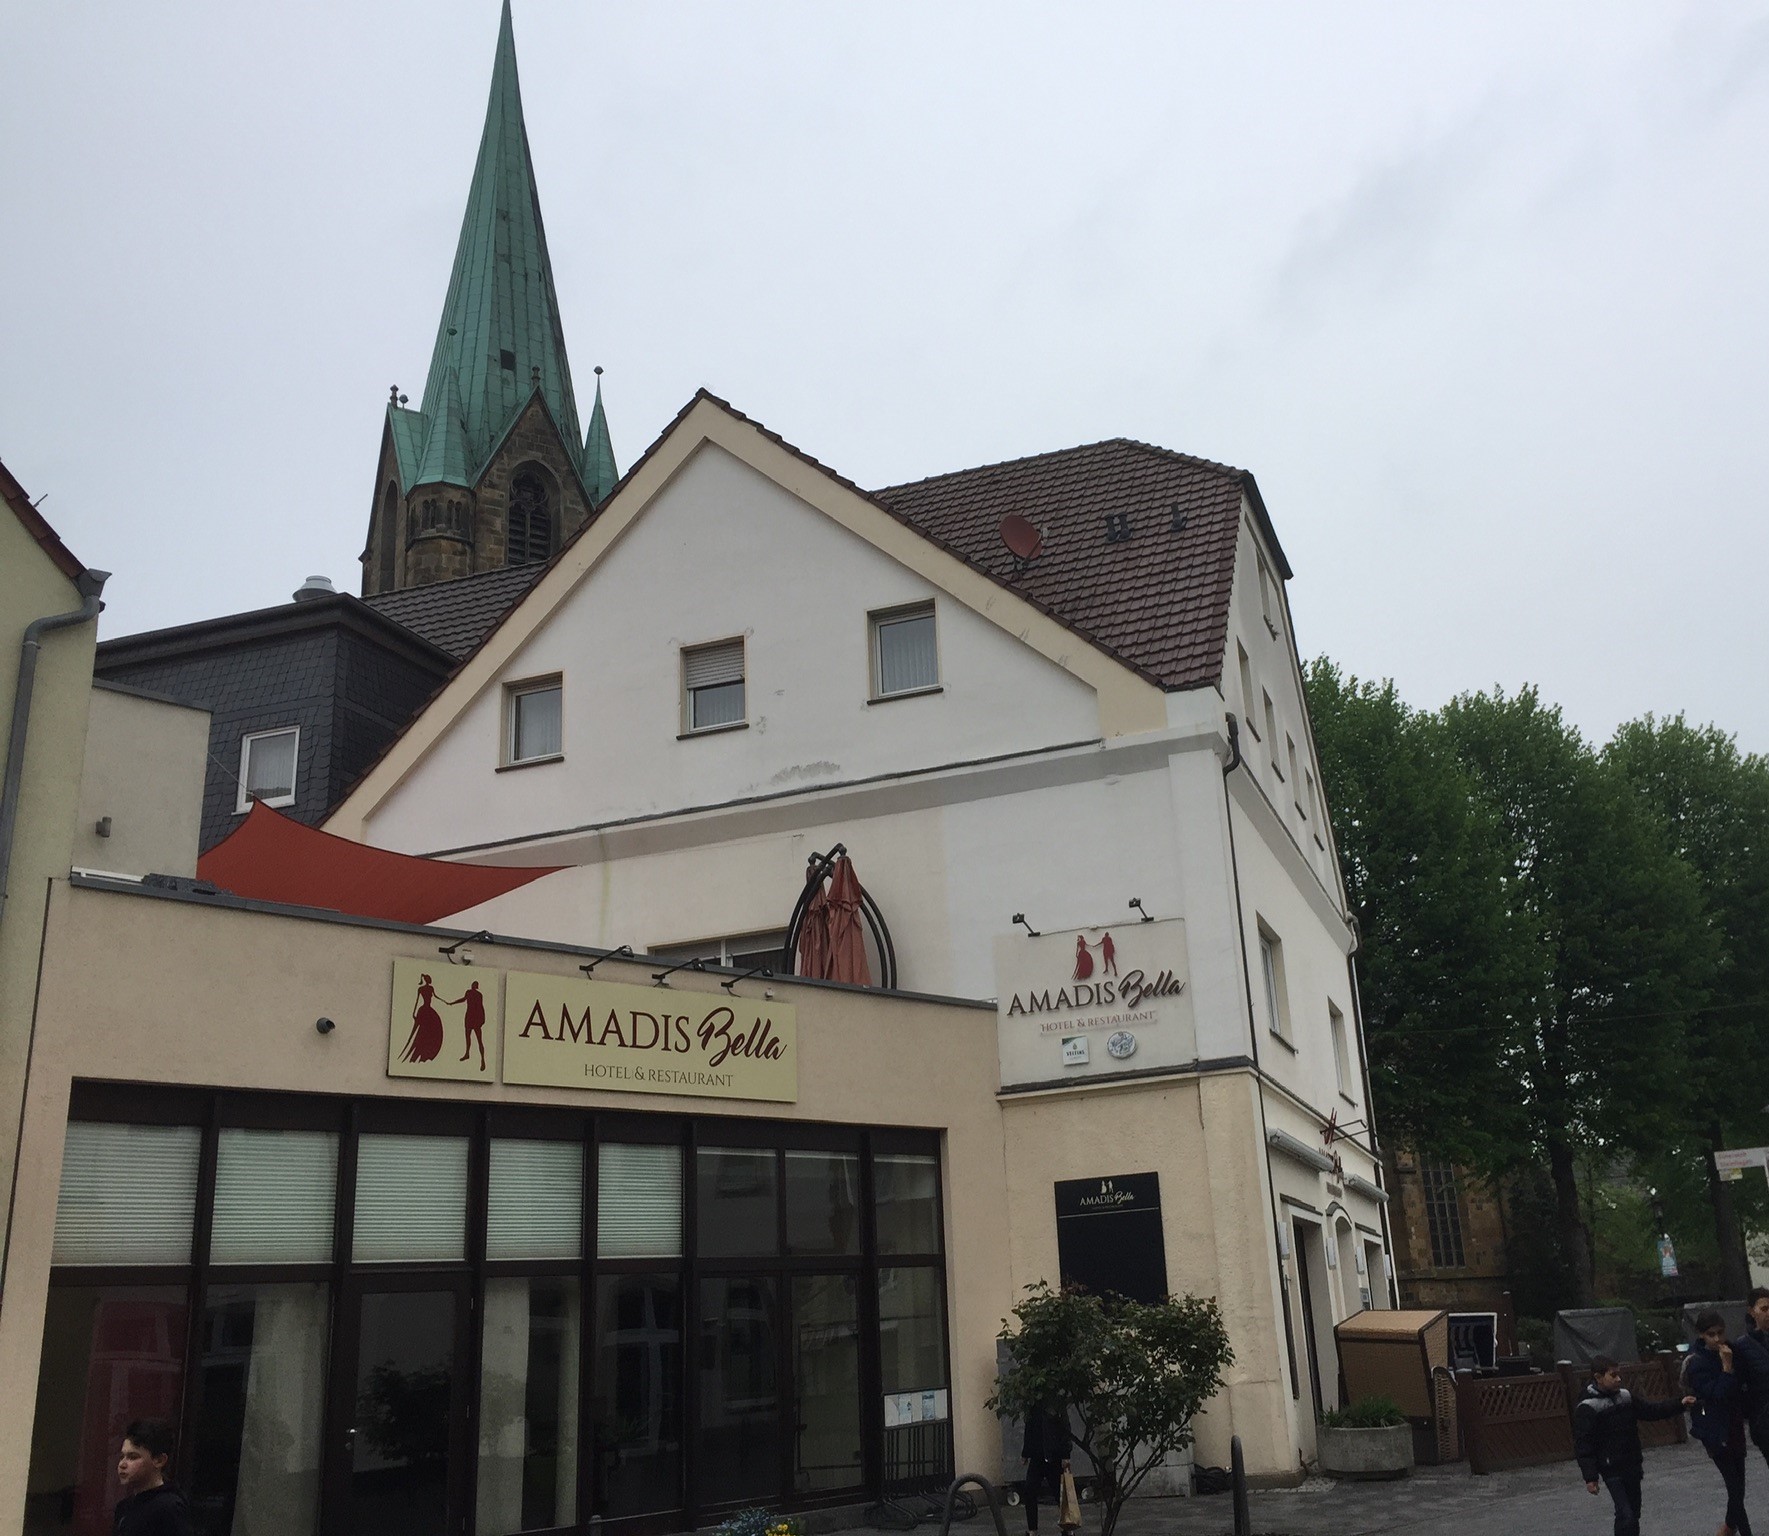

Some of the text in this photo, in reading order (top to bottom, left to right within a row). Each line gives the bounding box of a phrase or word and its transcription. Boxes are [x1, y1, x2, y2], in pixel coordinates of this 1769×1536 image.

[1007, 969, 1186, 1016] AMADIS Bella
[519, 999, 788, 1067] AMADIS Bella
[1041, 1020, 1075, 1032] HOTEL
[1087, 1011, 1156, 1026] RESTAURANT
[584, 1063, 734, 1087] HOTEL & RESTAURANT
[1080, 1194, 1114, 1206] AMADIS
